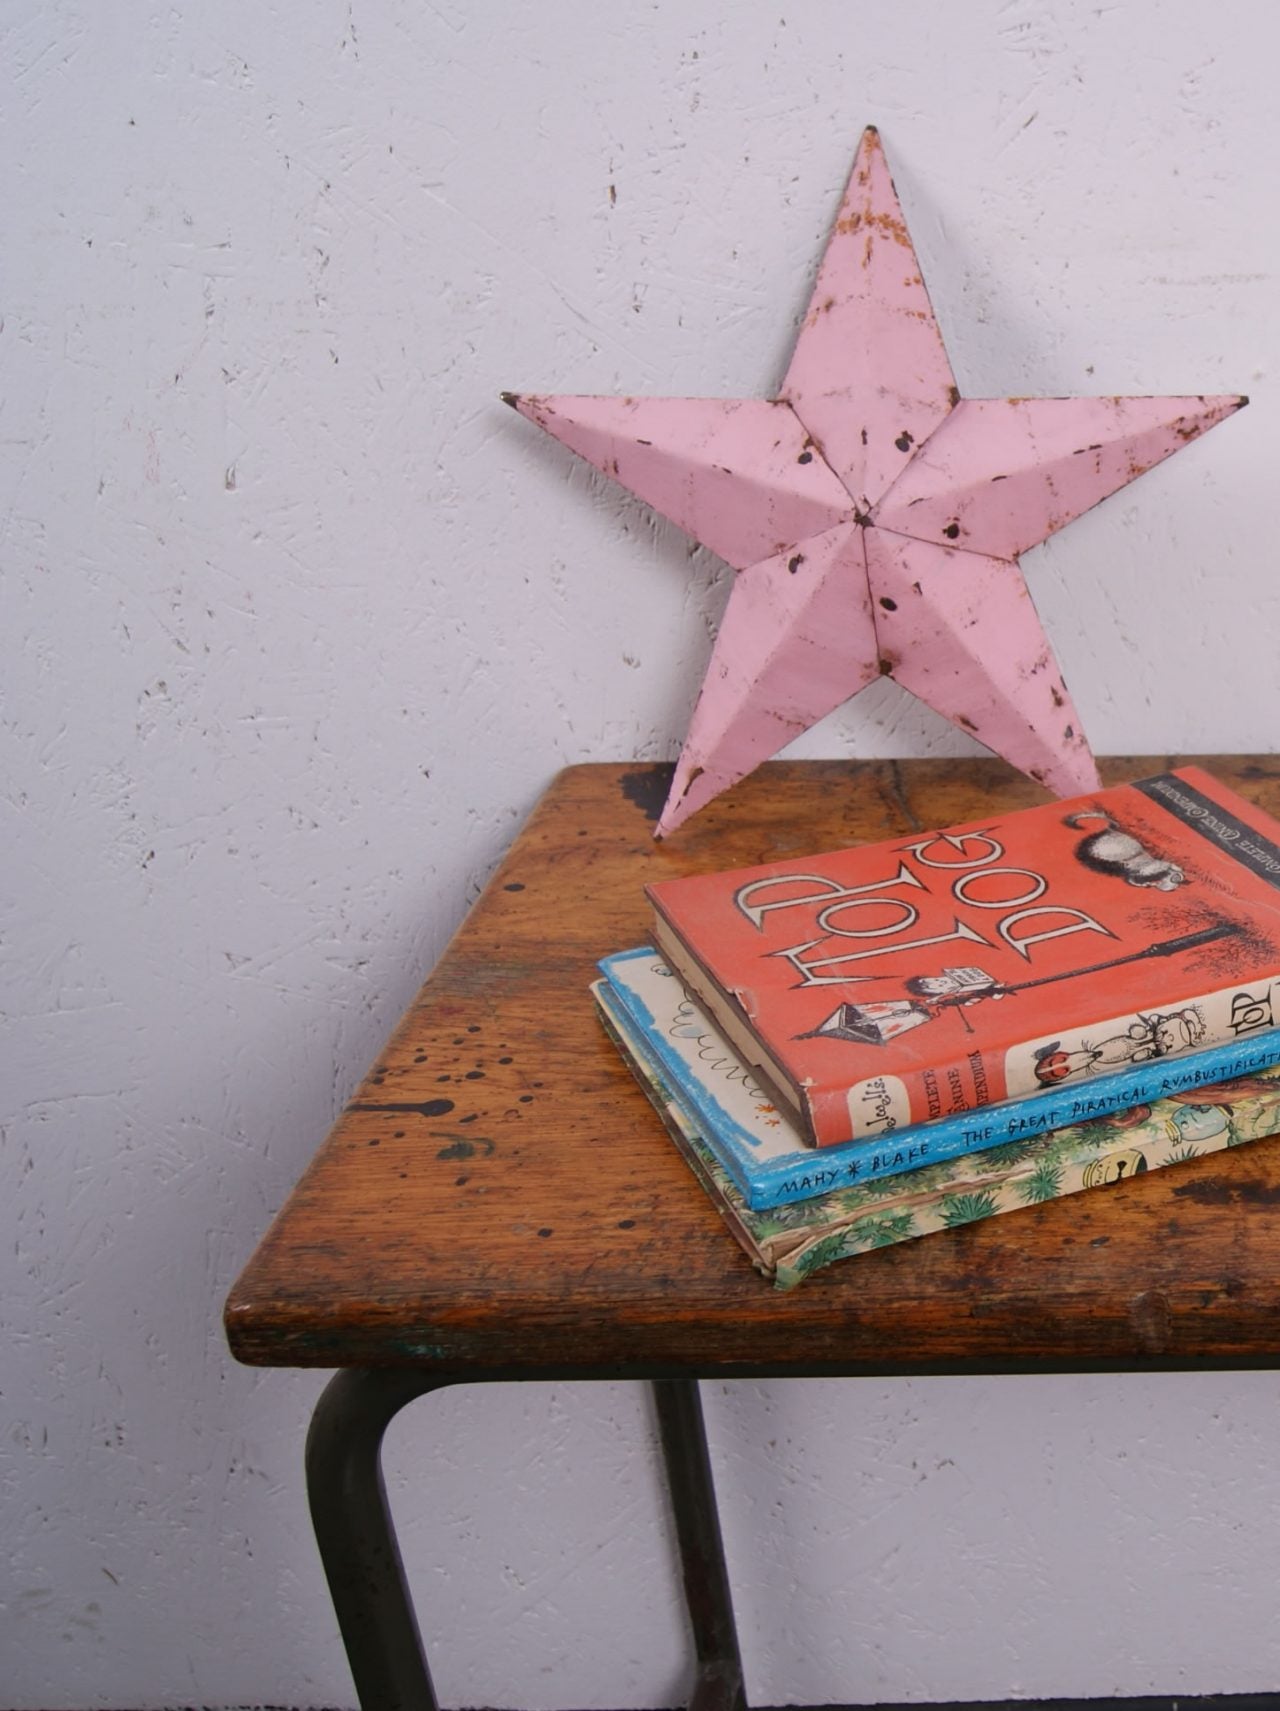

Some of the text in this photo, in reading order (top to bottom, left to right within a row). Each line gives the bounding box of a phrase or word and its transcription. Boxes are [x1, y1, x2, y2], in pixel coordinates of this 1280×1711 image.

[734, 859, 1001, 990] TOP
[890, 825, 1122, 963] DOG
[1226, 984, 1274, 1036] TOP
[776, 1168, 840, 1197] MAHY
[872, 1144, 930, 1171] BLAKE
[962, 1127, 993, 1147] THE
[1008, 1111, 1059, 1136] GREAT
[1071, 1086, 1148, 1119] PIRATICAL
